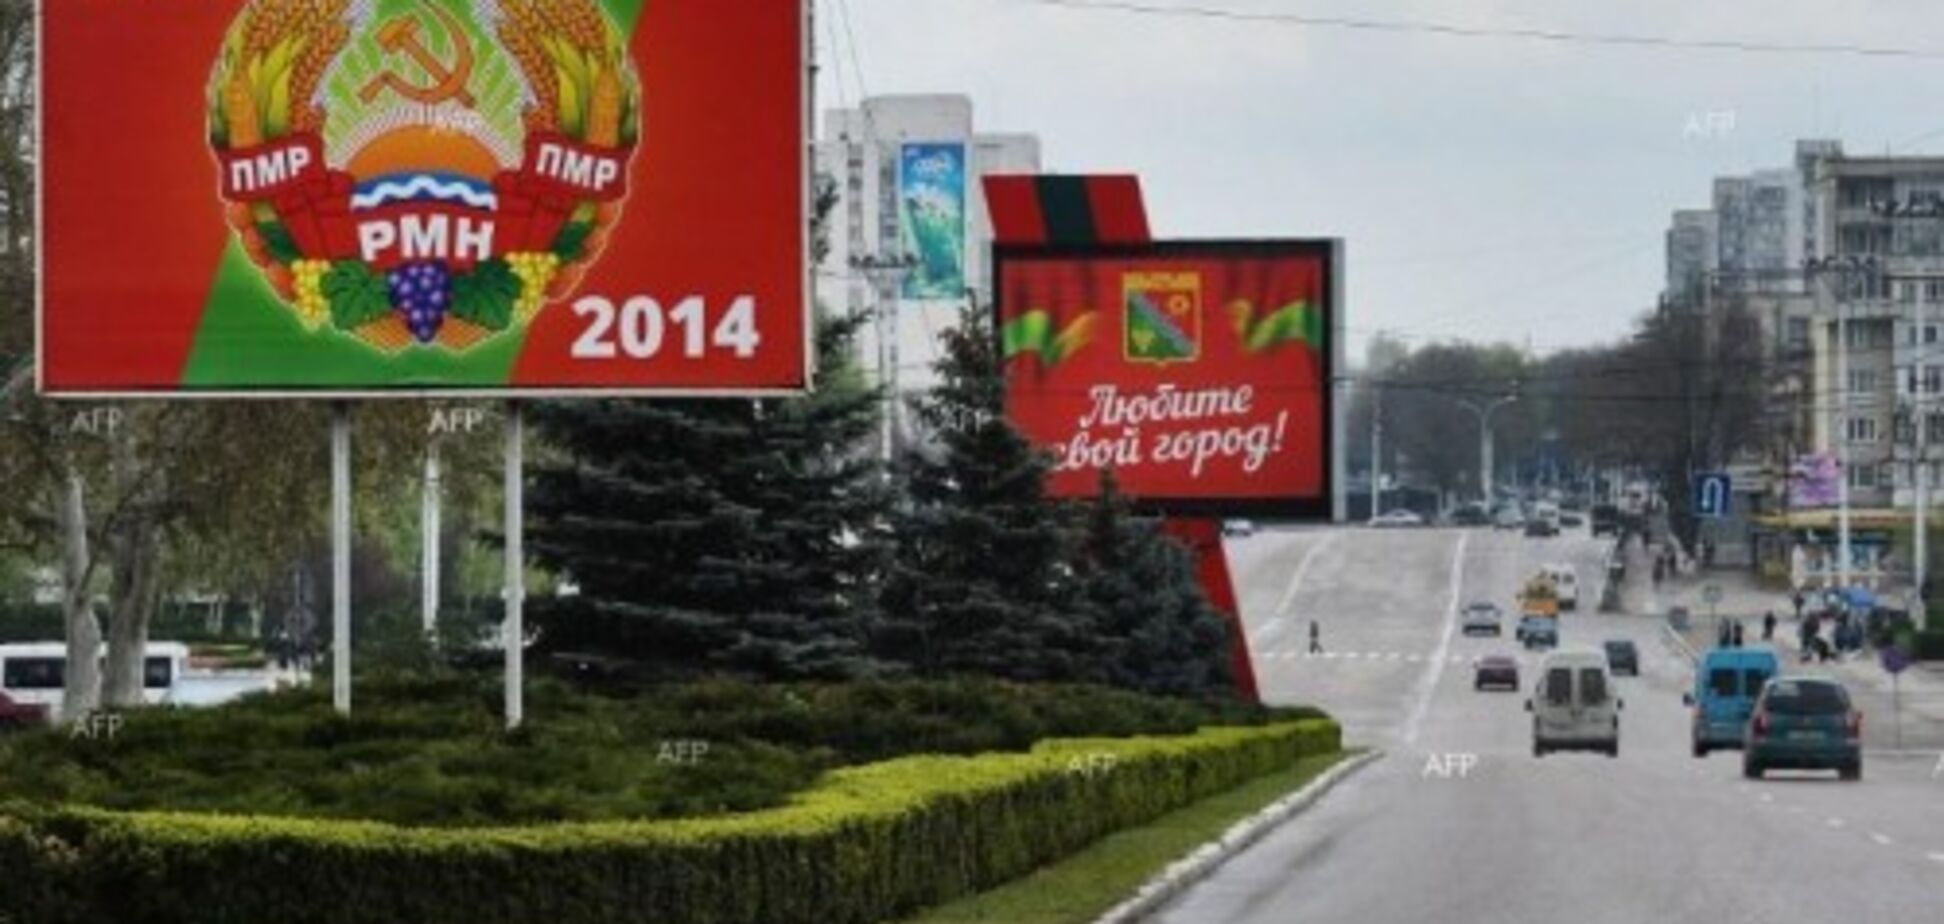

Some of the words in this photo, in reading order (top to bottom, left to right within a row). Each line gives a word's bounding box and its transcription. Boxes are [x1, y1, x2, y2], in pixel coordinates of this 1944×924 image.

[231, 146, 310, 192] ПМР
[536, 143, 617, 190] ПМР
[359, 214, 494, 261] РМН
[570, 294, 760, 359] 2014
[1079, 384, 1253, 429] Любите
[1152, 410, 1289, 477] город!
